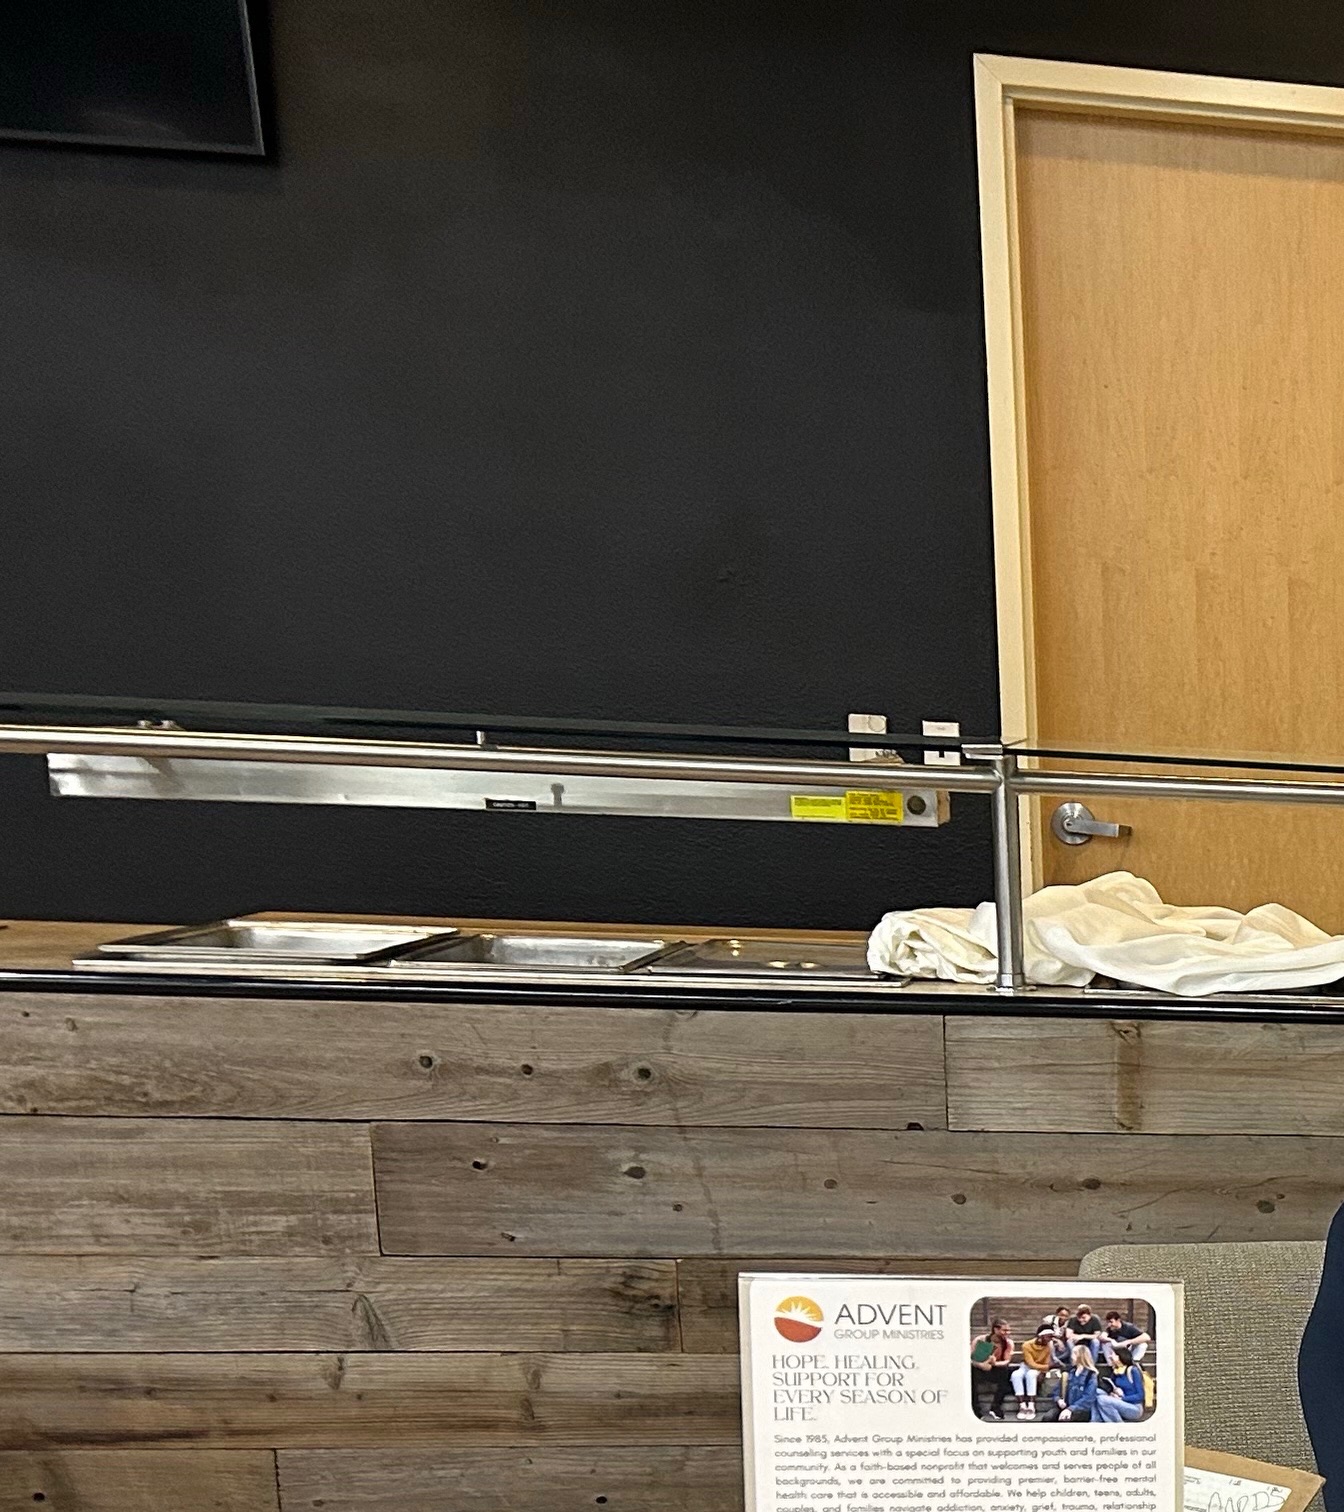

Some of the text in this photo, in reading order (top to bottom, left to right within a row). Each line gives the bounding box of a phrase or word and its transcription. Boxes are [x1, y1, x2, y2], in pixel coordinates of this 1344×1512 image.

[834, 1303, 947, 1325] ADVENT
[834, 1329, 945, 1340] GROUP MINISTRIES
[772, 1354, 920, 1370] HOPE. HEALING.
[772, 1372, 904, 1386] SUPPORT FOR
[773, 1389, 949, 1404] EVERY SEASON OF
[774, 1406, 817, 1421] LIFE.
[774, 1433, 1157, 1445] Since 1985, Advent Group Ministries has provided compassionate, professional
[774, 1448, 827, 1459] counseling
[830, 1449, 869, 1457] services
[872, 1448, 893, 1457] with
[905, 1448, 940, 1459] special
[943, 1448, 969, 1457] focus
[987, 1448, 1038, 1459] supporting
[1041, 1448, 1067, 1458] youth
[1070, 1447, 1088, 1457] and
[1091, 1447, 1128, 1456] families
[1130, 1448, 1138, 1456] in
[774, 1461, 1157, 1473] community. As a faith-based nonprofit that welcomes and serves people of all
